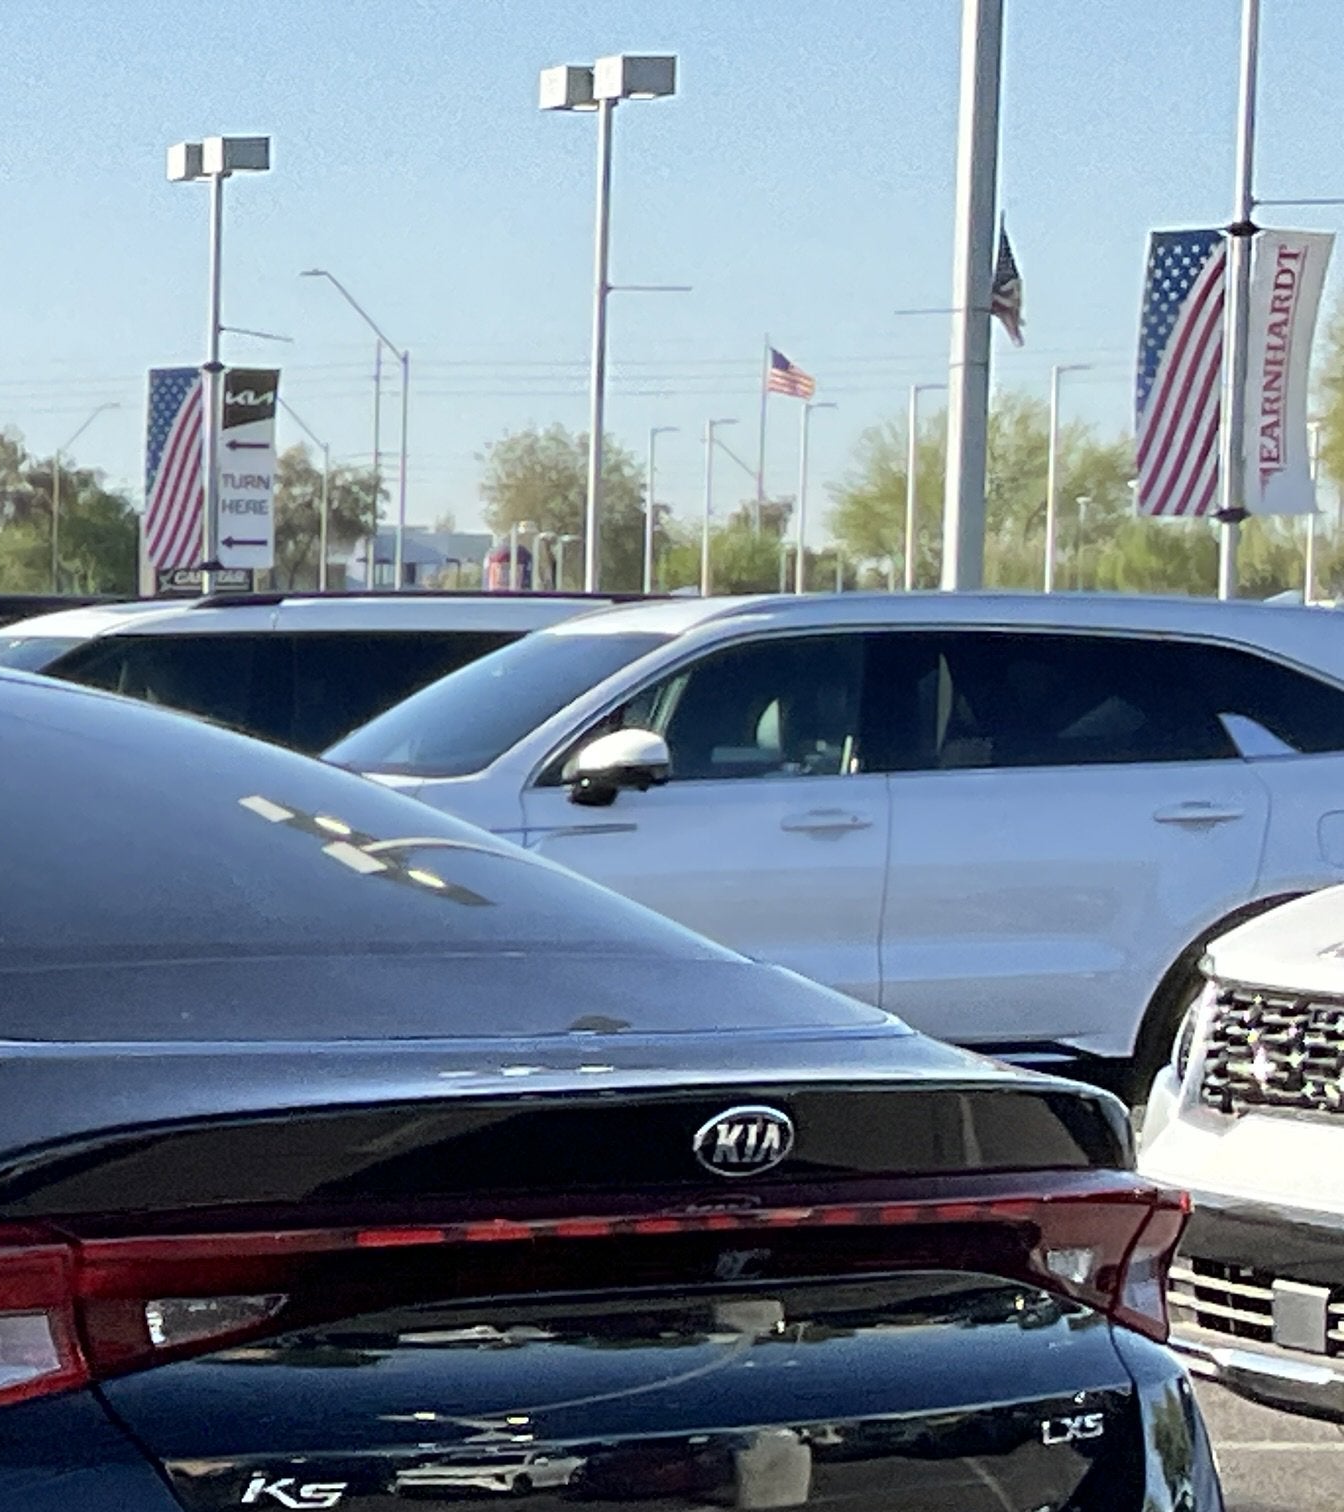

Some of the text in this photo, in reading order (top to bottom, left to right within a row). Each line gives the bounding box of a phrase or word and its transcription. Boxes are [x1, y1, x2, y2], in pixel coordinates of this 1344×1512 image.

[1259, 243, 1302, 465] EARNHARDT
[222, 473, 271, 491] TURN
[221, 498, 269, 515] HERE
[713, 1124, 782, 1163] KIA
[1041, 1413, 1104, 1446] LXS
[241, 1477, 348, 1510] K5
